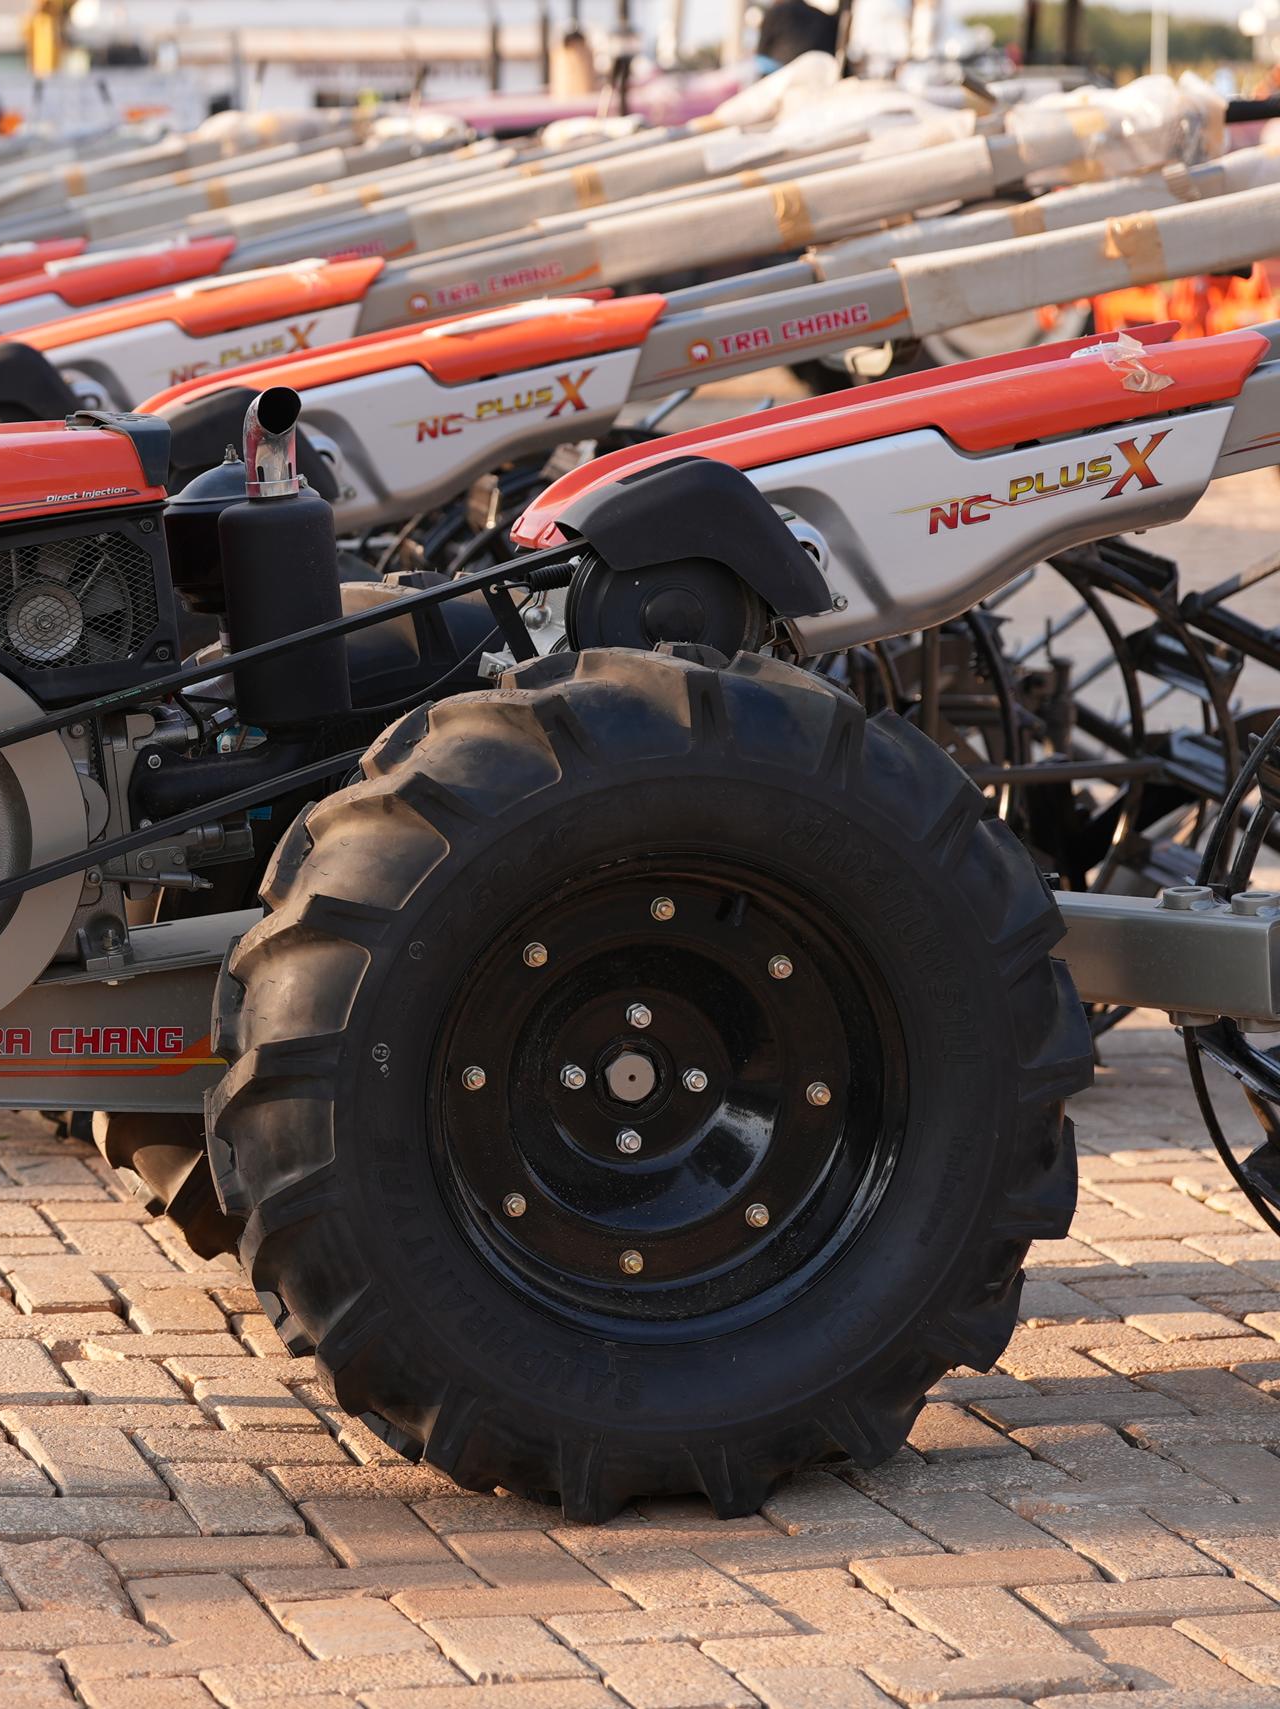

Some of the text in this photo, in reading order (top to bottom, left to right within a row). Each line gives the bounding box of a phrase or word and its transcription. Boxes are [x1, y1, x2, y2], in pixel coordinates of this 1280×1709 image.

[718, 303, 869, 354] TRA CHANG
[415, 413, 464, 442] NC
[45, 486, 127, 504] Direct Injection
[929, 494, 992, 534] NC
[49, 1026, 184, 1055] CHANG
